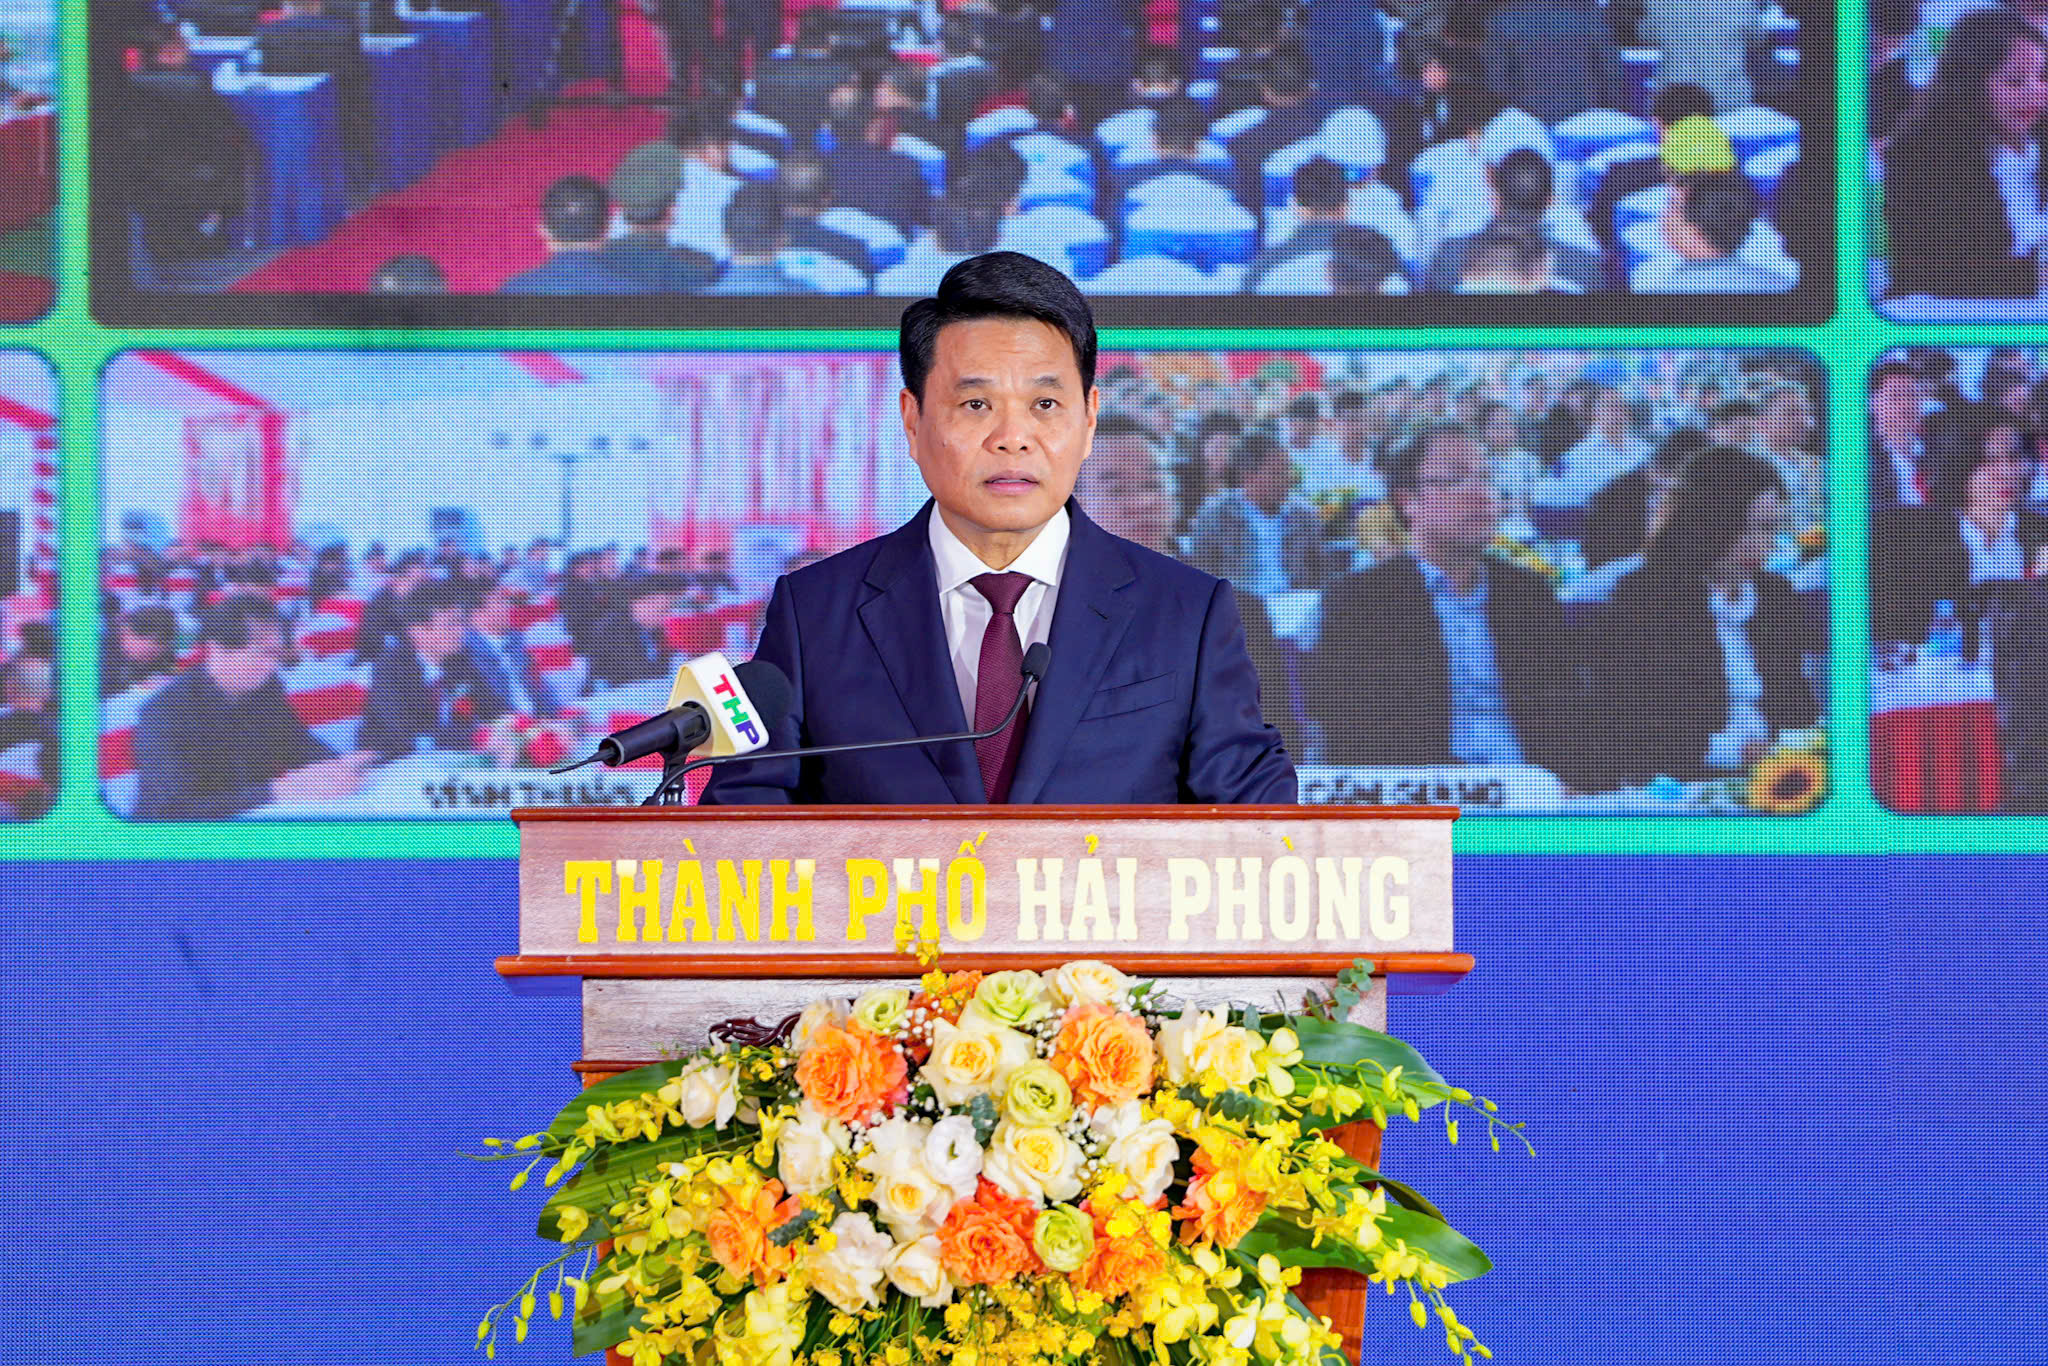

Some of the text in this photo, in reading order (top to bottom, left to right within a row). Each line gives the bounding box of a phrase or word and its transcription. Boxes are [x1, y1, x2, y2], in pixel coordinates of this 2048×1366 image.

[713, 673, 760, 745] THP
[564, 831, 1411, 943] THÀNH PHỐ HẢI PHÒNG
